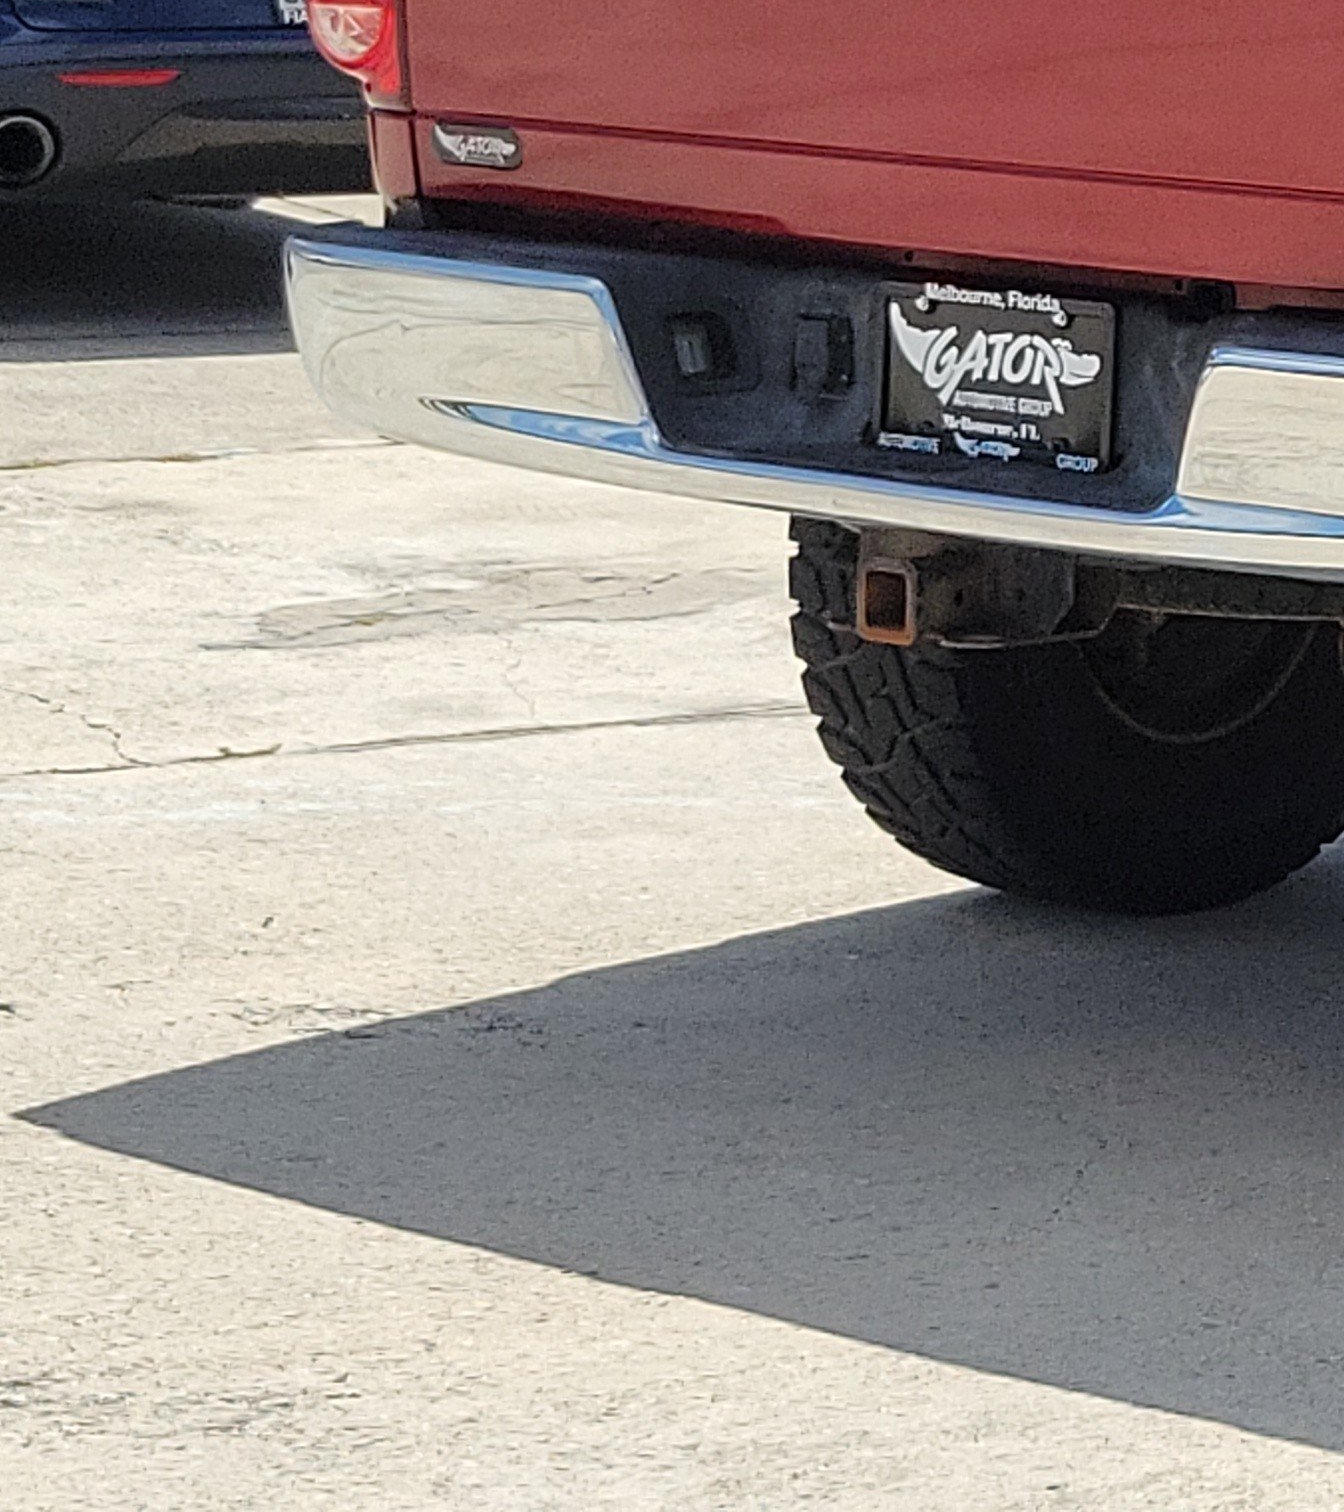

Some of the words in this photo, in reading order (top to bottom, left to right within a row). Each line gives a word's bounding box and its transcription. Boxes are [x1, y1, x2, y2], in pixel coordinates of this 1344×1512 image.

[925, 282, 1005, 311] Melbourne,
[1007, 290, 1062, 314] Florida
[923, 325, 1065, 415] GATOR
